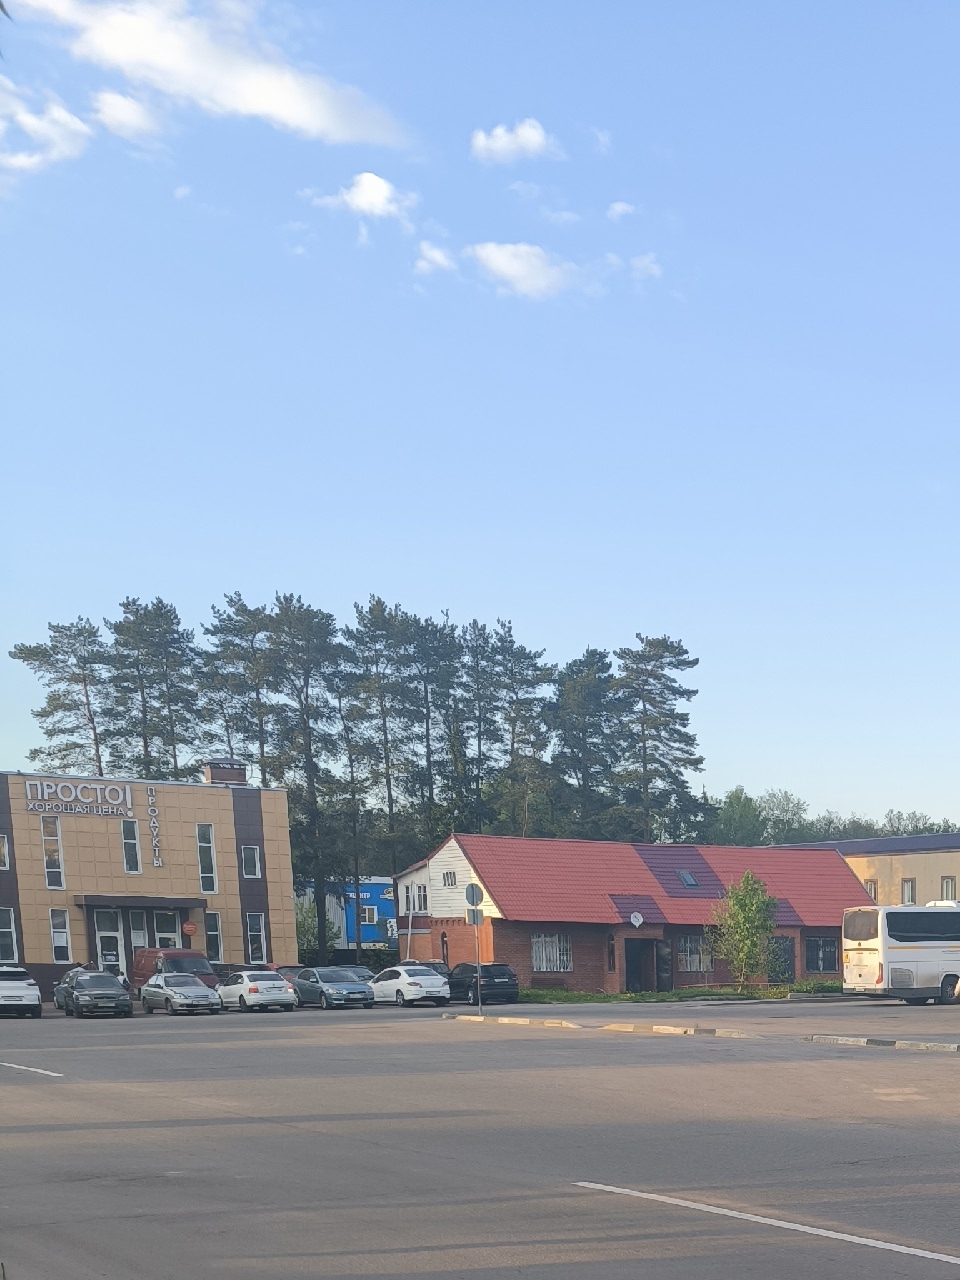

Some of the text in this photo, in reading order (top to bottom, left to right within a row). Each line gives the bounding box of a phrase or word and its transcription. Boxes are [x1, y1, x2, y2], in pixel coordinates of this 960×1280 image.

[27, 802, 126, 816] ХОРОШАЯ ЦЕНА
[147, 786, 163, 867] ПРОДУКТЫ
